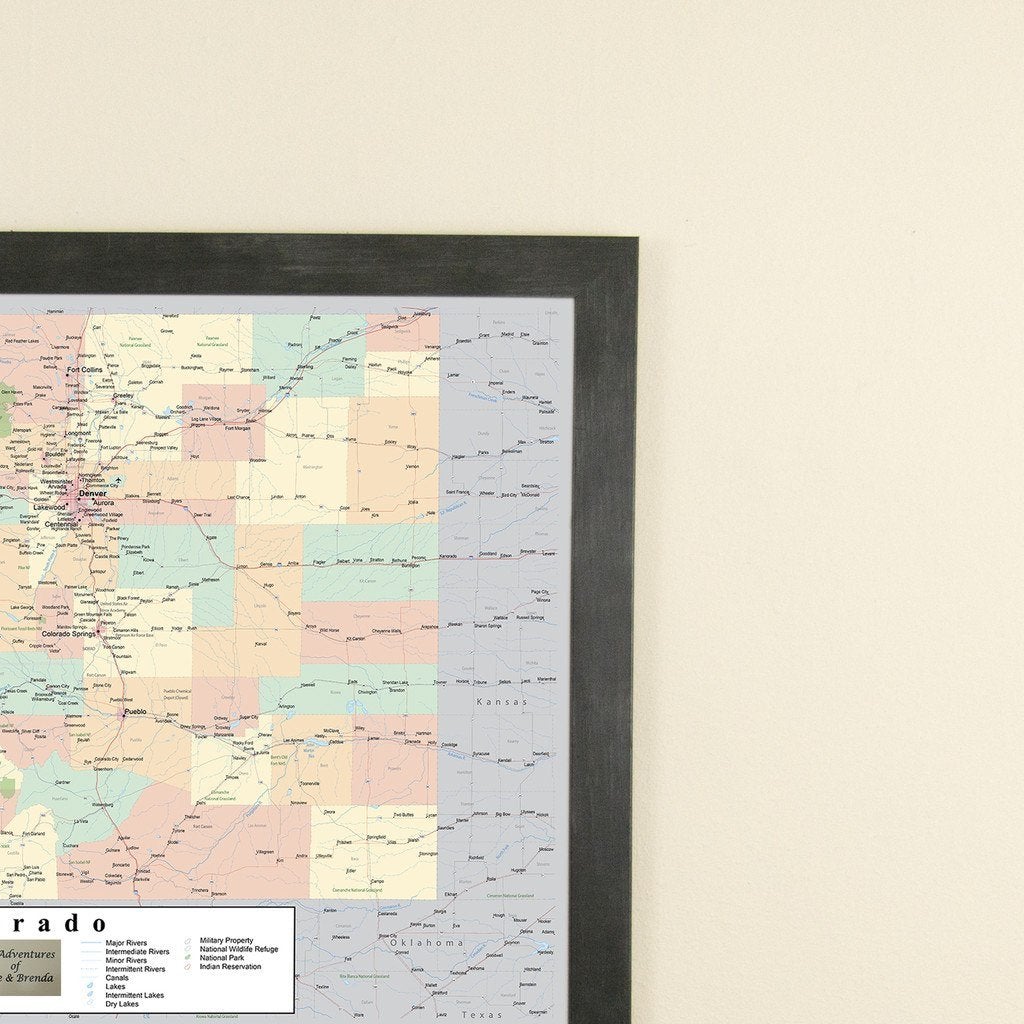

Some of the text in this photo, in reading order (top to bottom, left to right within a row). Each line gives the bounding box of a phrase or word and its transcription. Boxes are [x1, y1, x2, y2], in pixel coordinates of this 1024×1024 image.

[477, 698, 527, 706] Kansas
[390, 939, 463, 947] Oklahoma
[255, 946, 278, 954] Refuge
[11, 961, 22, 973] of
[5, 974, 14, 983] &
[17, 974, 54, 983] Brenda
